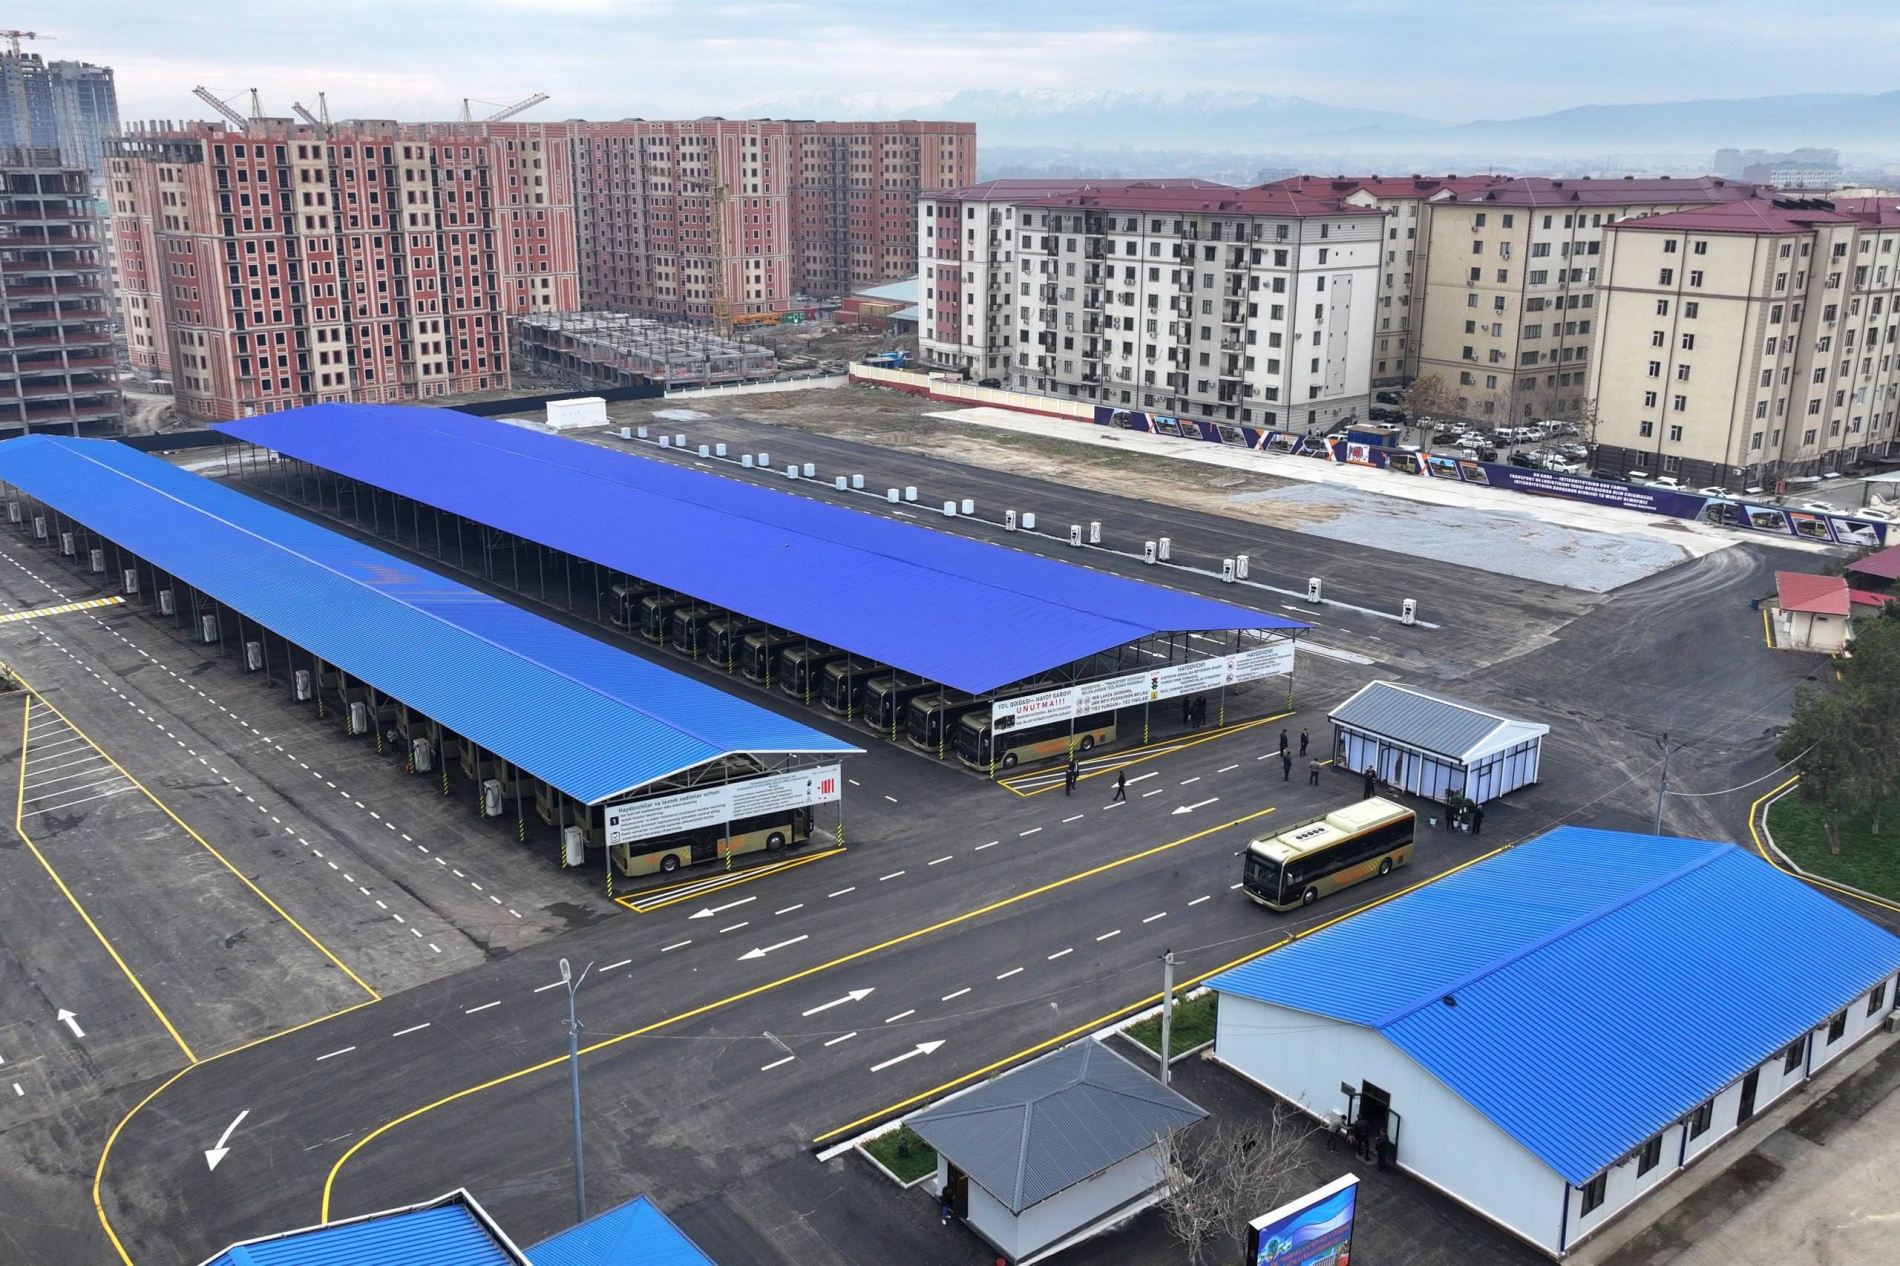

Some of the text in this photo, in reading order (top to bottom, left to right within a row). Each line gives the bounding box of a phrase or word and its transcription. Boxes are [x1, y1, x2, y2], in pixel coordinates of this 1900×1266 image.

[1509, 473, 1535, 481] TRANSPORT
[1036, 694, 1051, 702] HAYOT
[1053, 690, 1071, 698] GAROVI
[1016, 698, 1065, 713] UNUTMA!!!
[619, 802, 652, 813] Haydovchilar
